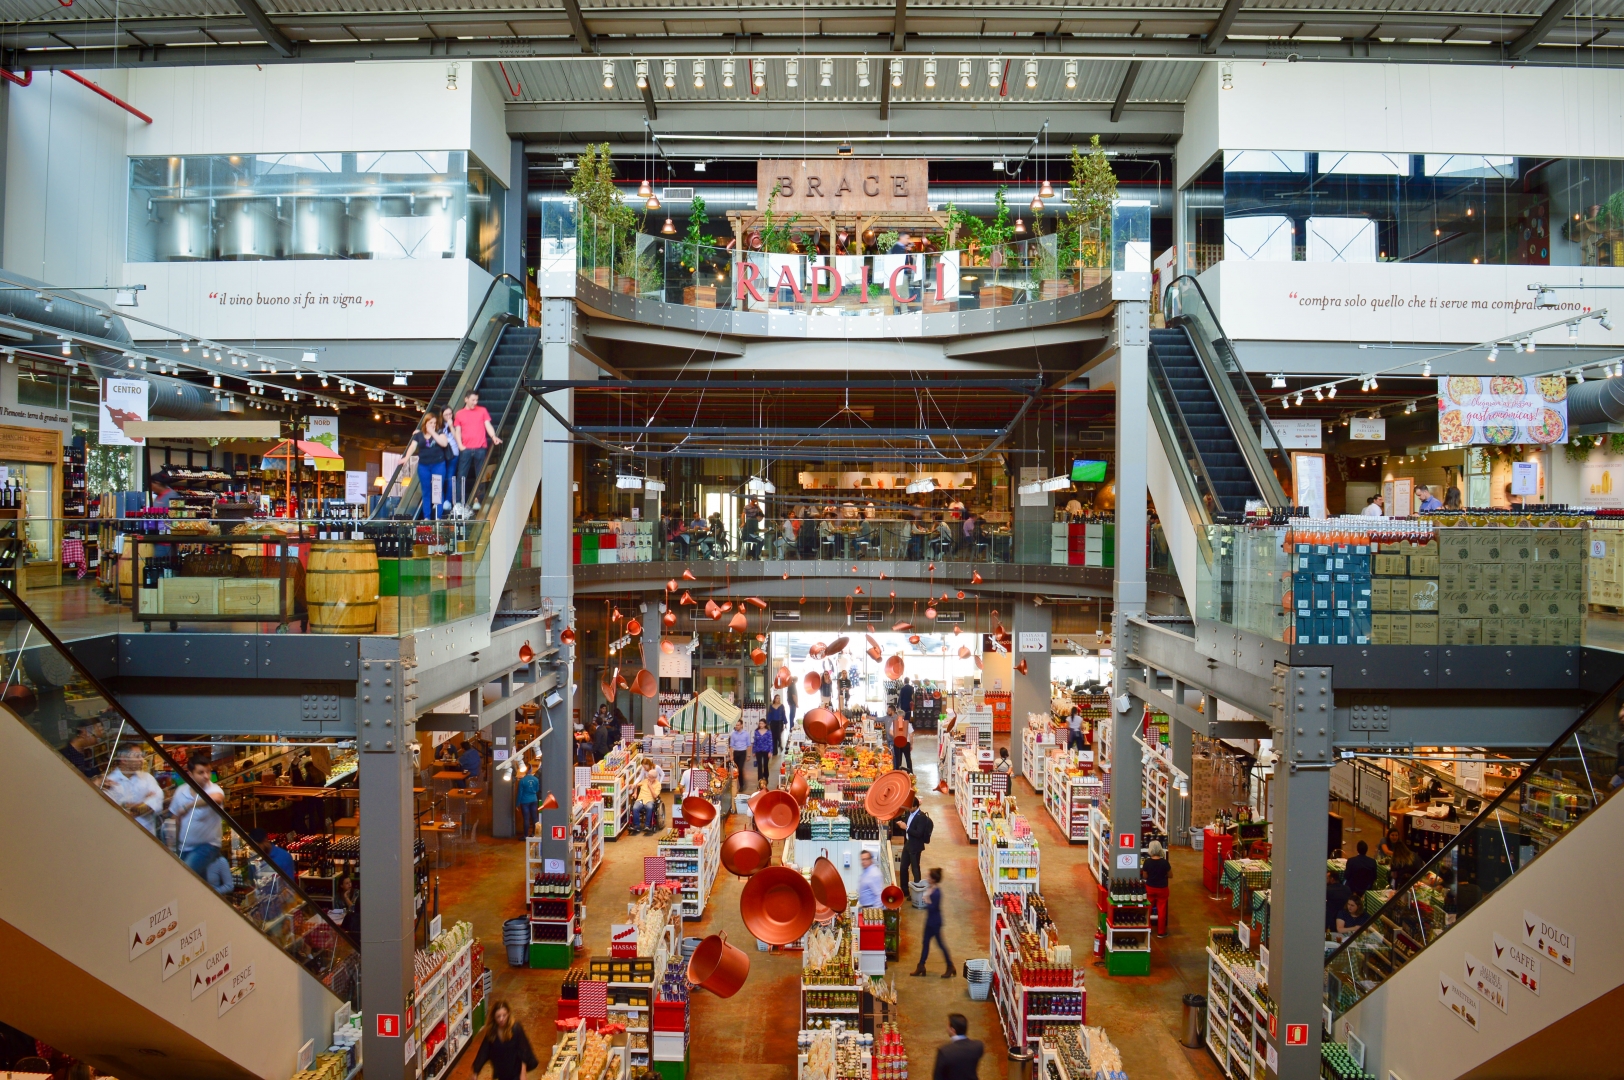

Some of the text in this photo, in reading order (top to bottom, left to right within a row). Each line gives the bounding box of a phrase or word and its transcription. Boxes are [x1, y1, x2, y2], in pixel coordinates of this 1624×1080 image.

[777, 175, 910, 198] BRACE
[735, 261, 946, 304] RADICI
[229, 294, 252, 305] vino
[256, 292, 290, 305] buono
[293, 294, 302, 305] si
[302, 292, 315, 308] fa
[318, 294, 329, 304] in
[1344, 294, 1366, 307] solo
[1370, 294, 1404, 311] quello
[1408, 295, 1426, 308] che
[1429, 296, 1437, 308] ti
[1440, 300, 1468, 309] serve
[1471, 300, 1488, 309] ma
[113, 385, 142, 394] CENTRO
[1466, 408, 1540, 425] gastronômicas!
[149, 906, 172, 928] PIZZA
[180, 928, 202, 949] PASTA
[1541, 922, 1570, 949] DOLCI
[206, 946, 228, 970] CARNE
[1510, 947, 1535, 972] CAFFÈ
[232, 966, 252, 988] PESCE
[1452, 985, 1477, 1009] PANETTERIA
